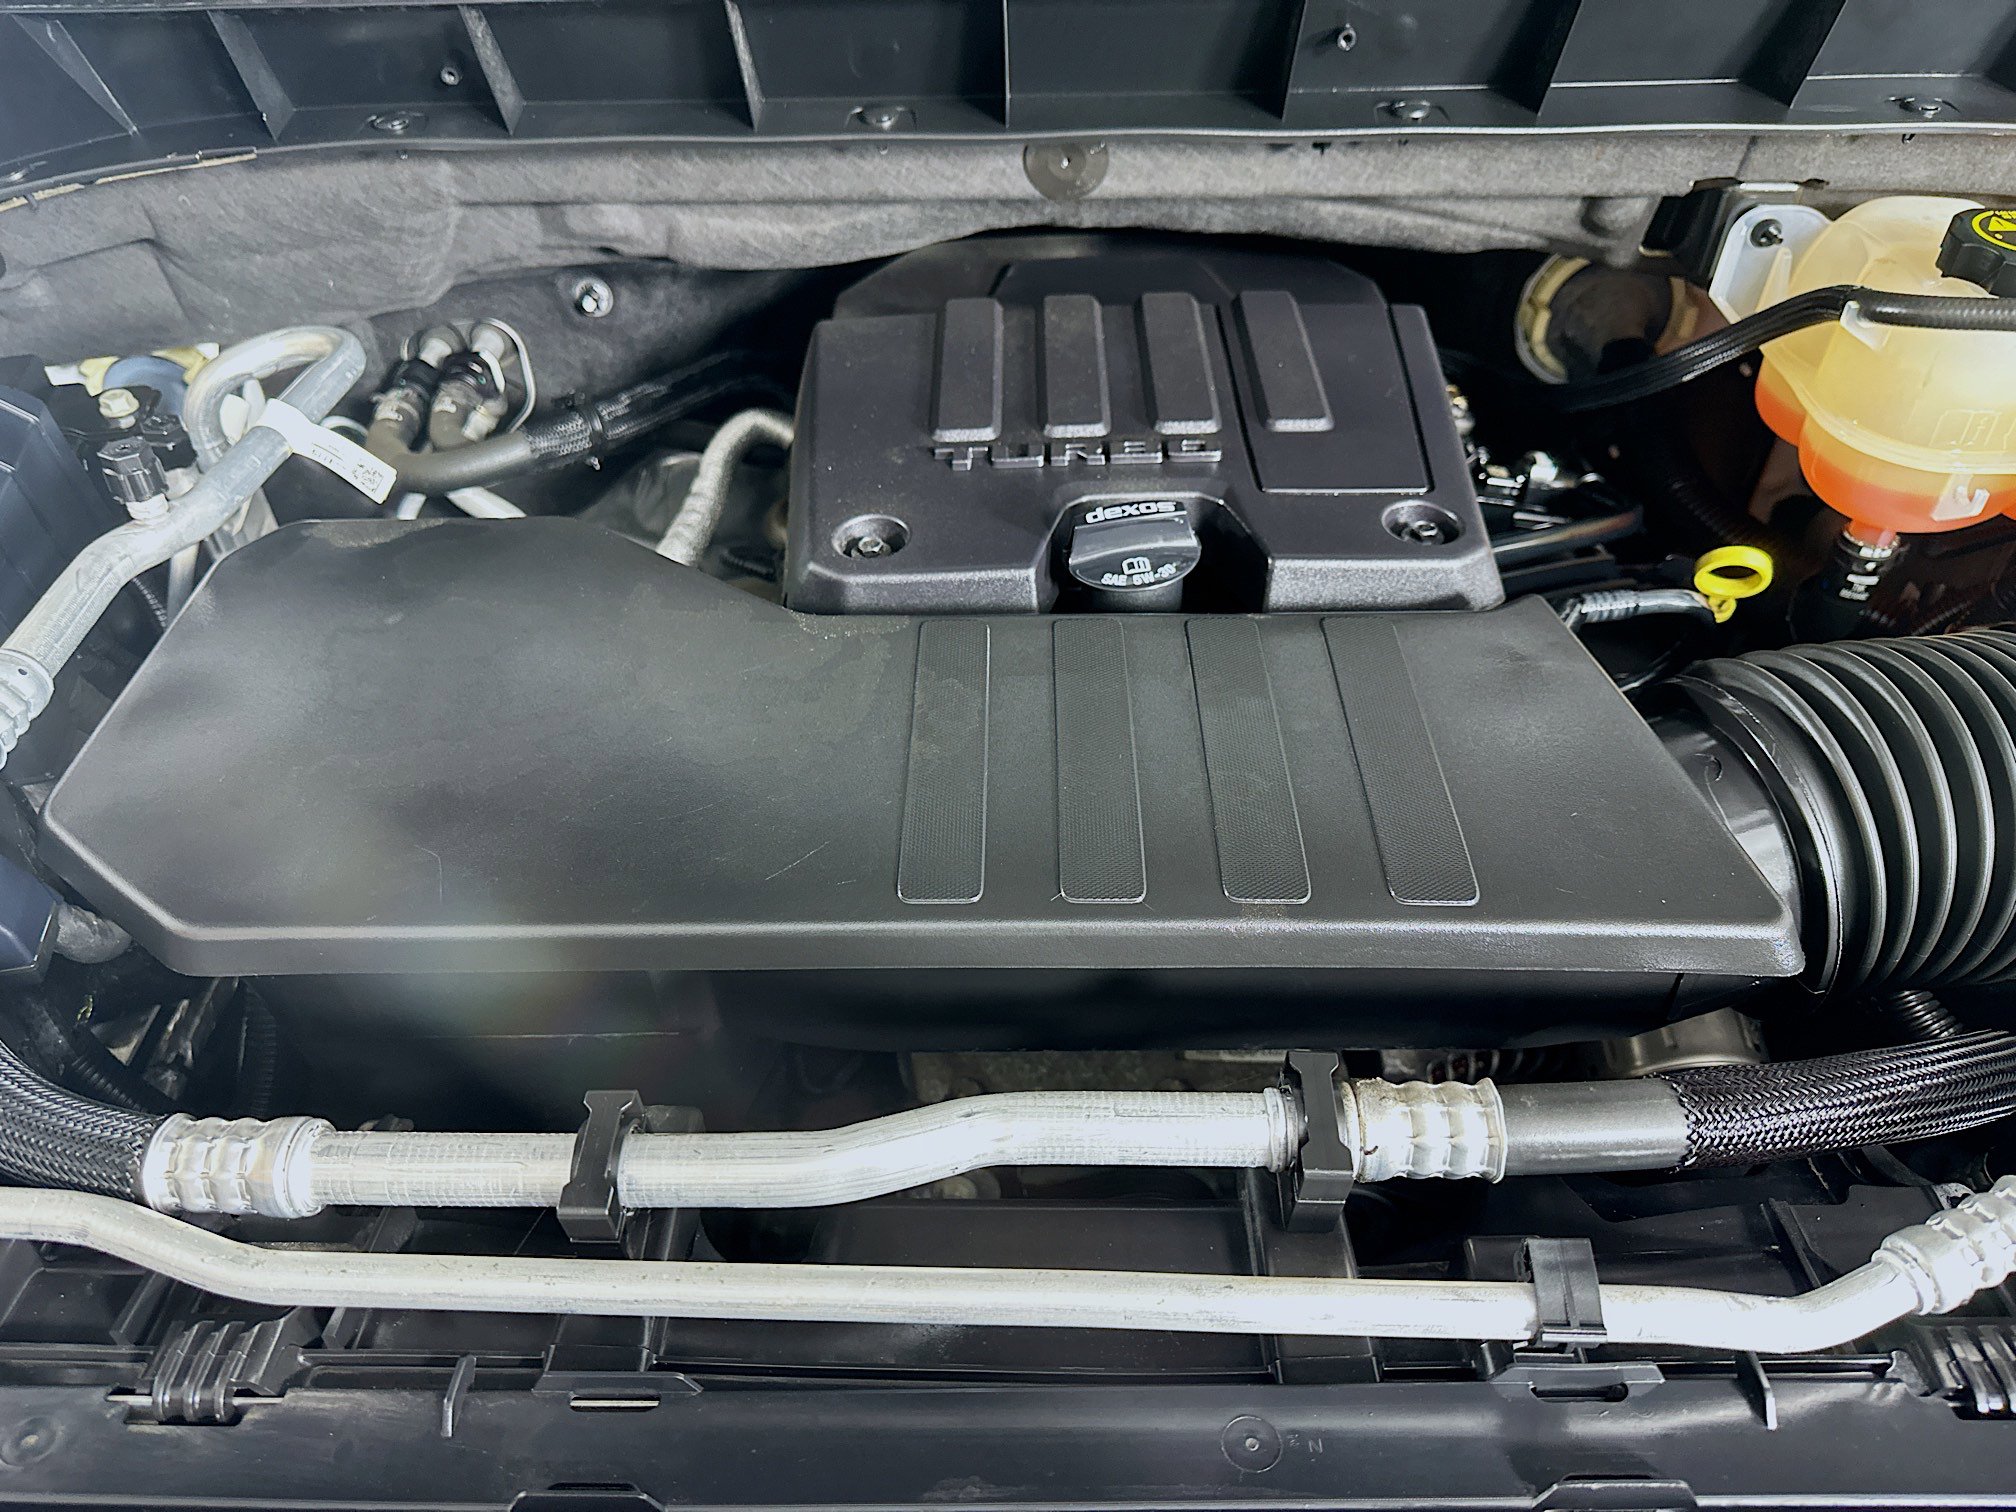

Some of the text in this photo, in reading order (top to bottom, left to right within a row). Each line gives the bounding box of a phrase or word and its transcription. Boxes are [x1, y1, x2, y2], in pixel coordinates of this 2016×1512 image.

[932, 438, 1222, 471] TURBO
[1085, 501, 1177, 524] dexos
[1101, 563, 1175, 586] SAE 5W-30
